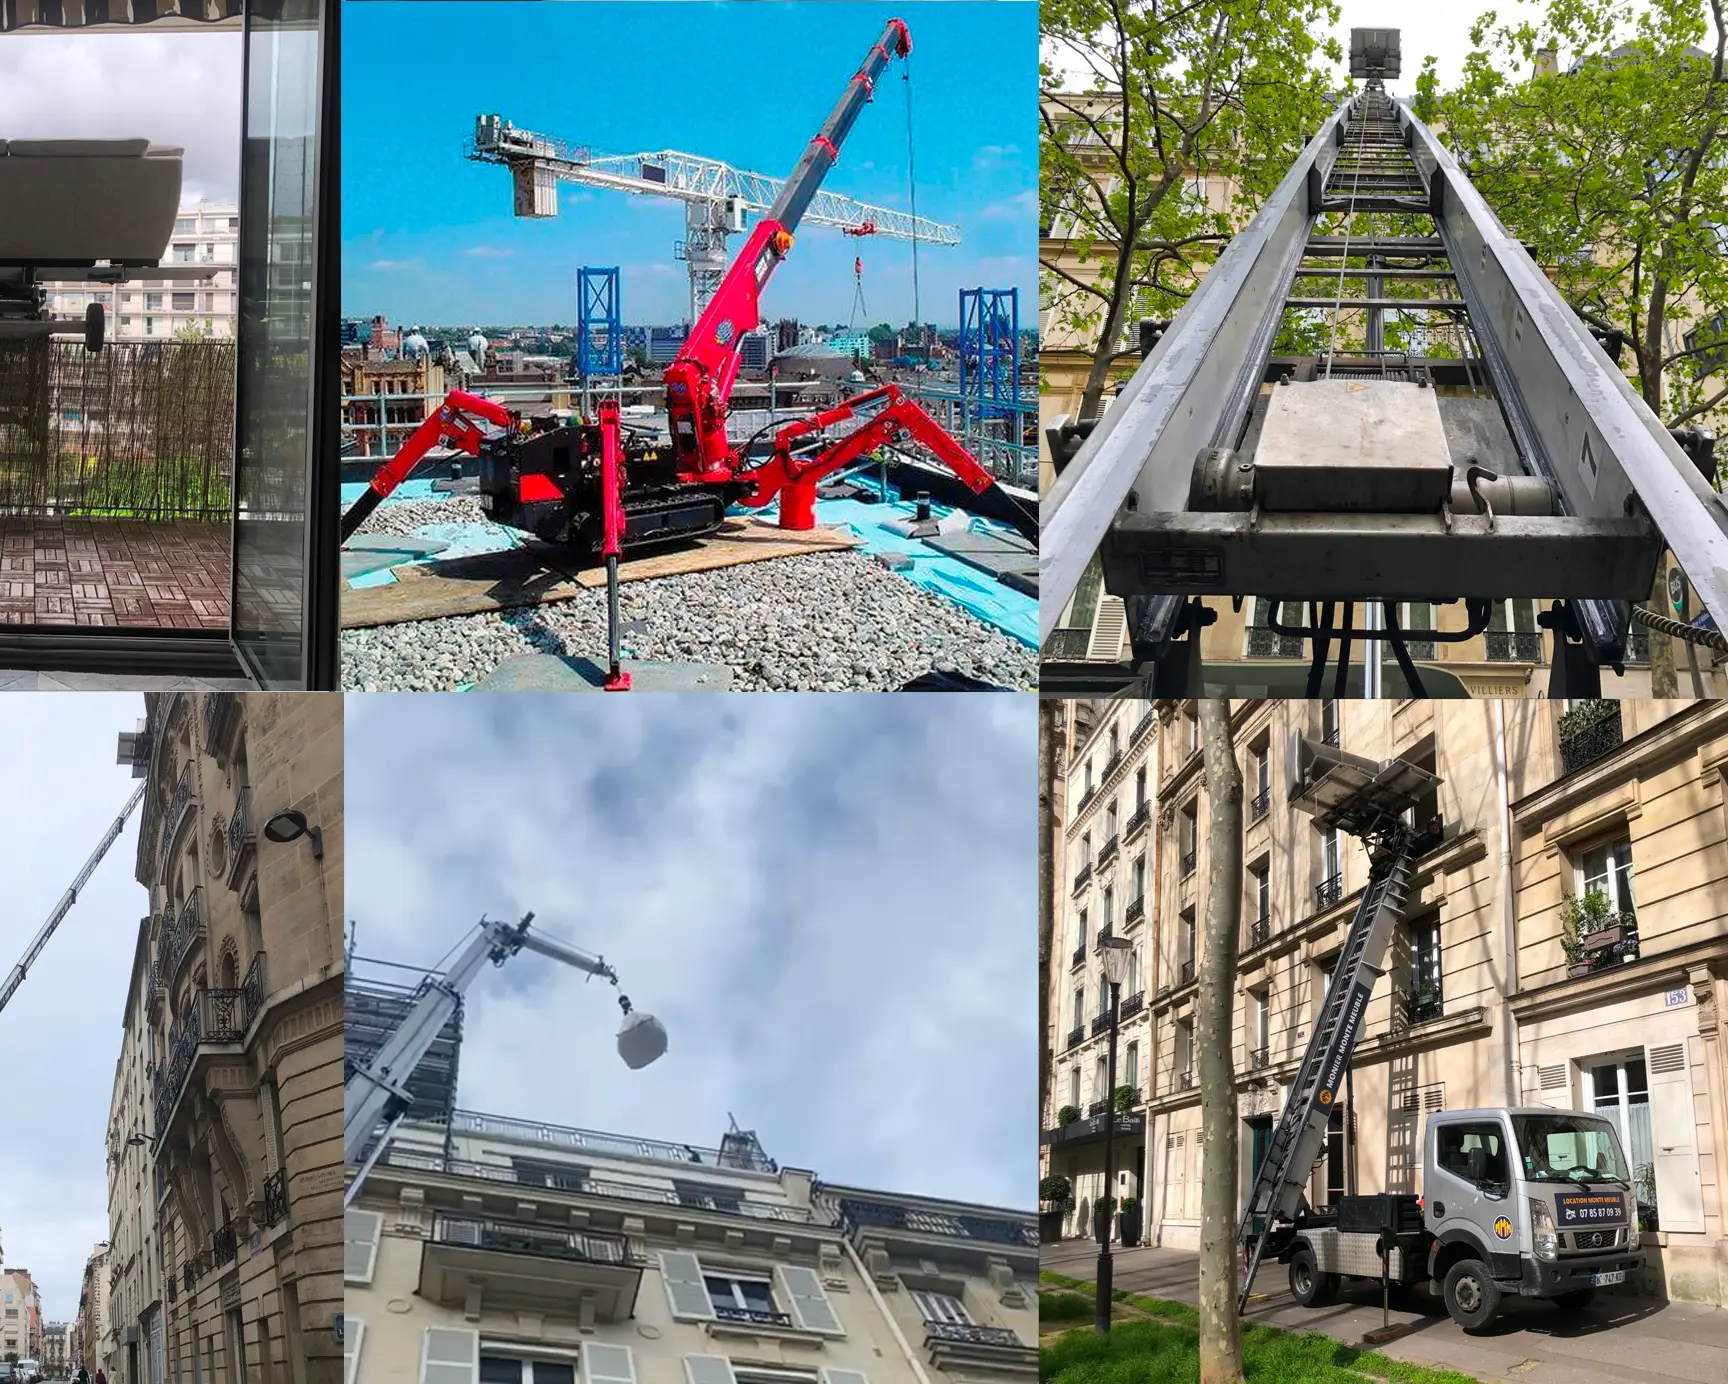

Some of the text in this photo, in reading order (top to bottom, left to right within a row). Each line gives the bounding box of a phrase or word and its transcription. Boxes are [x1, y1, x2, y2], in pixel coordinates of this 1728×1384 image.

[1470, 685, 1518, 695] VILLIERS
[1667, 989, 1687, 1005] 153
[1326, 1055, 1343, 1088] MONIER
[1338, 1023, 1353, 1053] MONTE
[1349, 992, 1364, 1024] MEUBLE
[1579, 1207, 1621, 1218] 07 85 87 09 39
